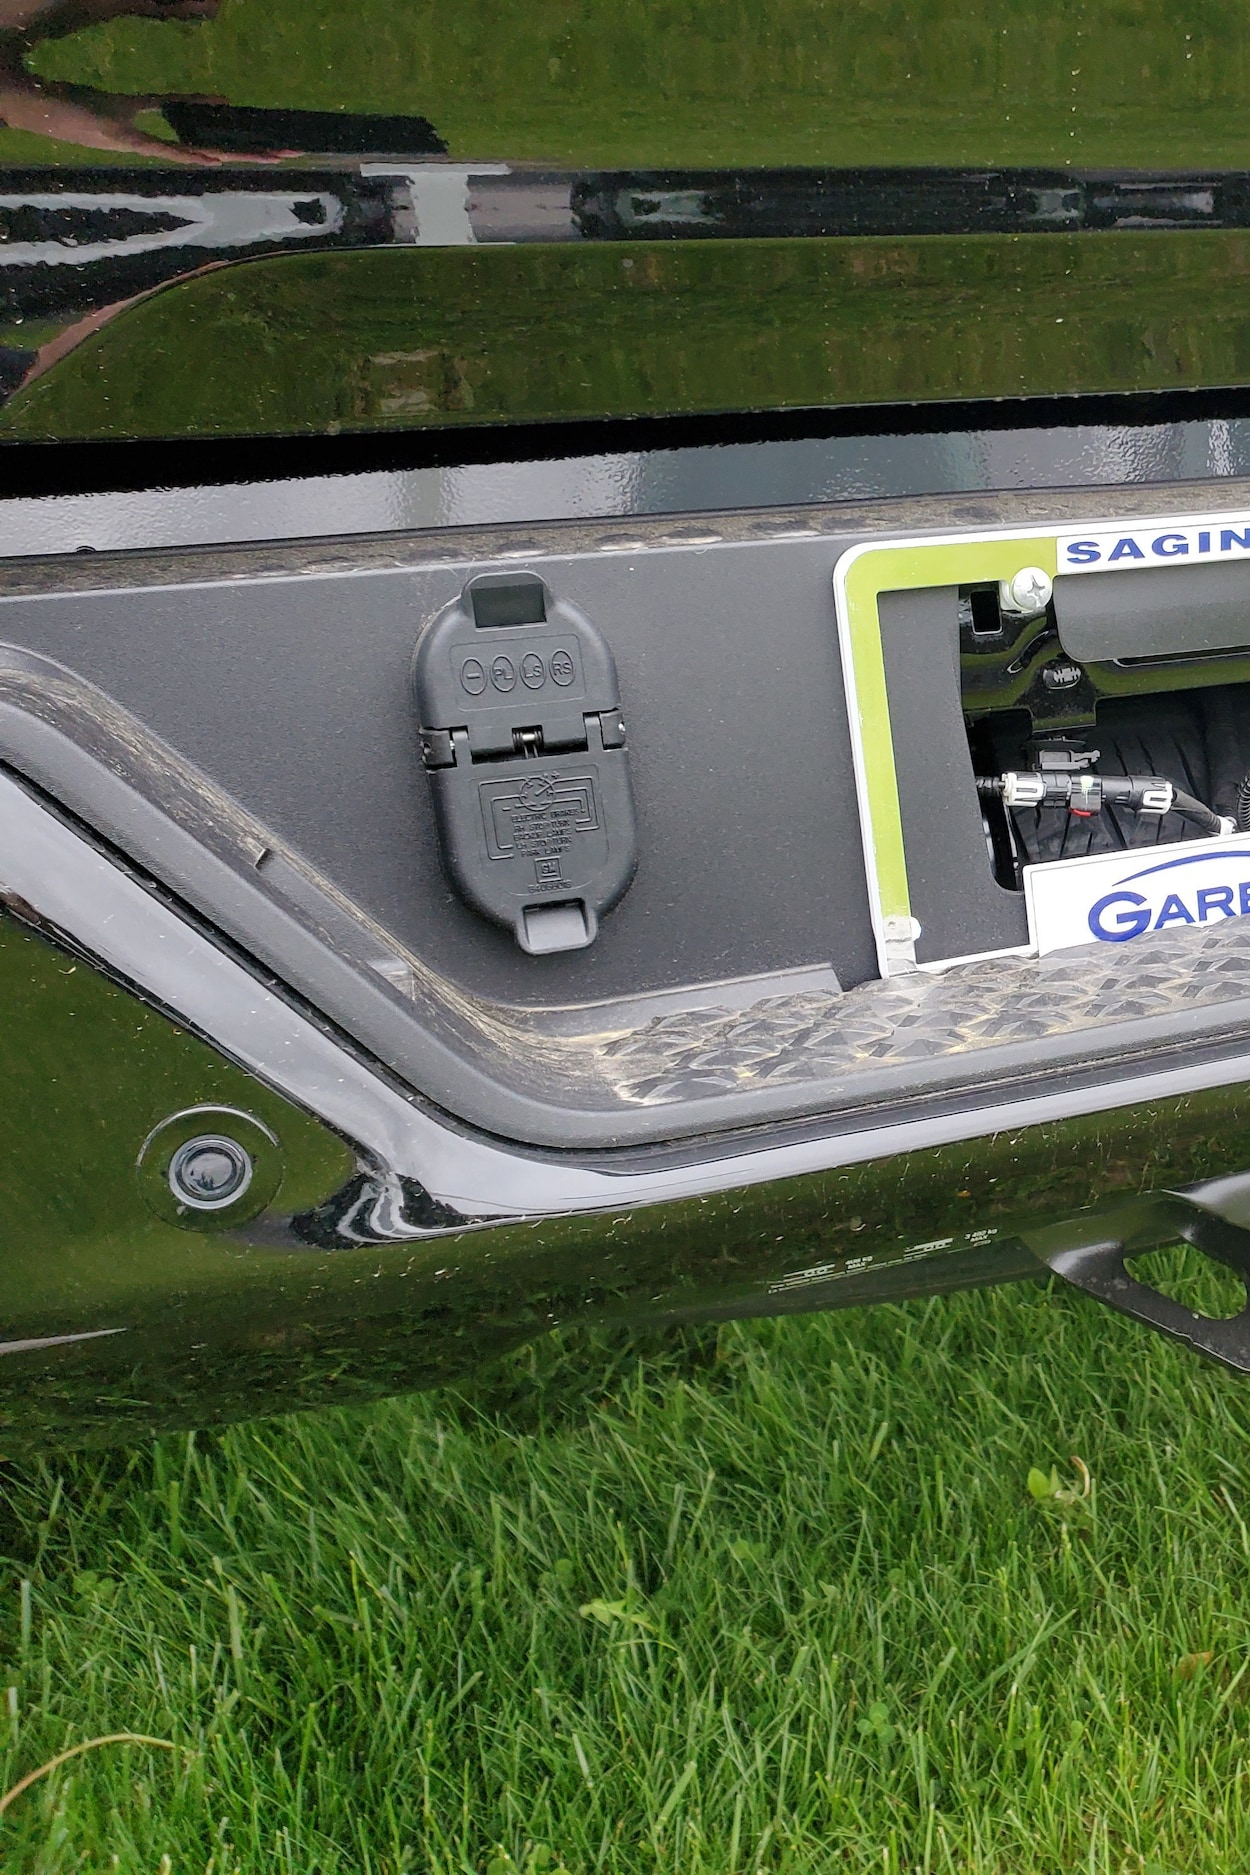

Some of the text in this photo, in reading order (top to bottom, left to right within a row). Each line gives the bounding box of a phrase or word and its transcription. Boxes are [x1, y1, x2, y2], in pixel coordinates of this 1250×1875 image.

[493, 660, 572, 682] PL LS RS
